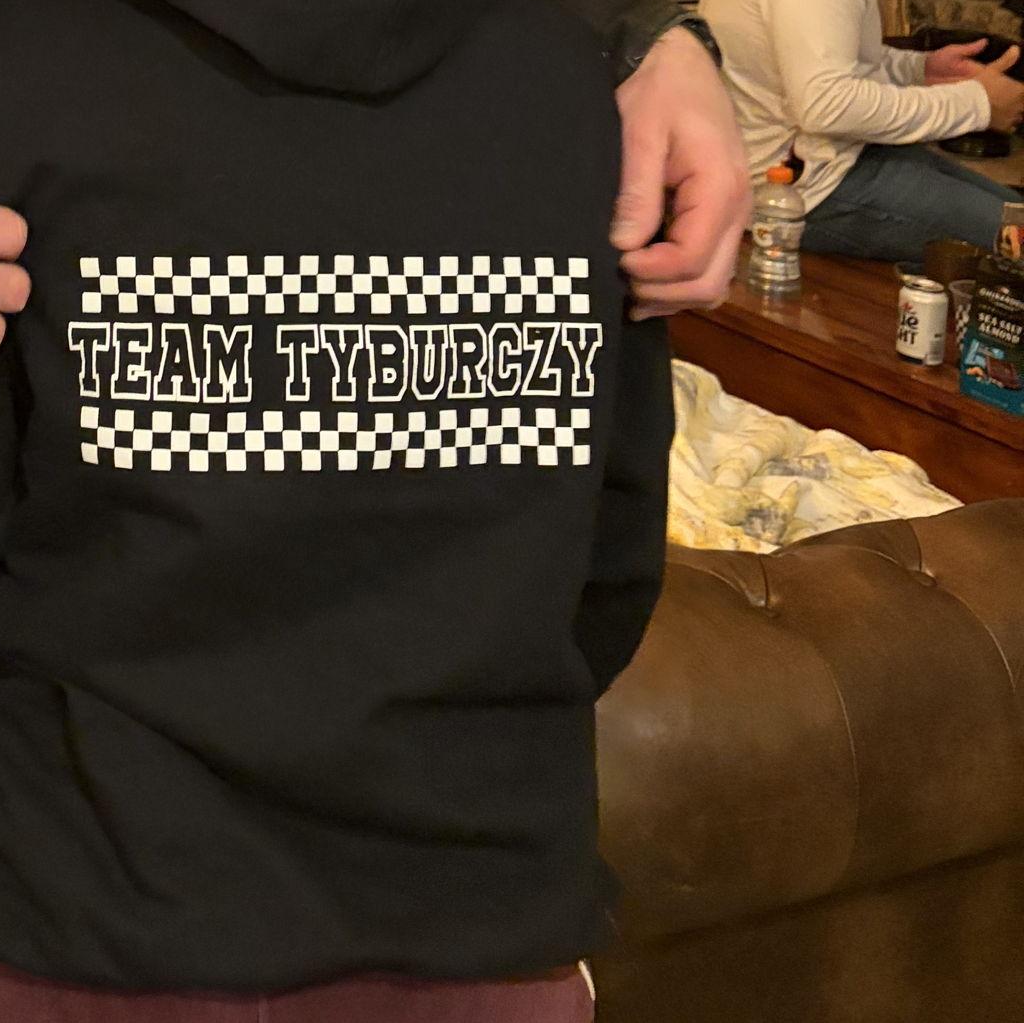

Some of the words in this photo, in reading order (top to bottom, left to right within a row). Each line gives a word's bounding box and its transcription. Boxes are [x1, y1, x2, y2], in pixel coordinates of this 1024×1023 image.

[977, 312, 997, 326] SEA
[1000, 320, 1023, 335] SALT
[978, 323, 1021, 343] ALMOND
[68, 322, 253, 404] TEAM
[277, 322, 603, 403] TYBURCZY
